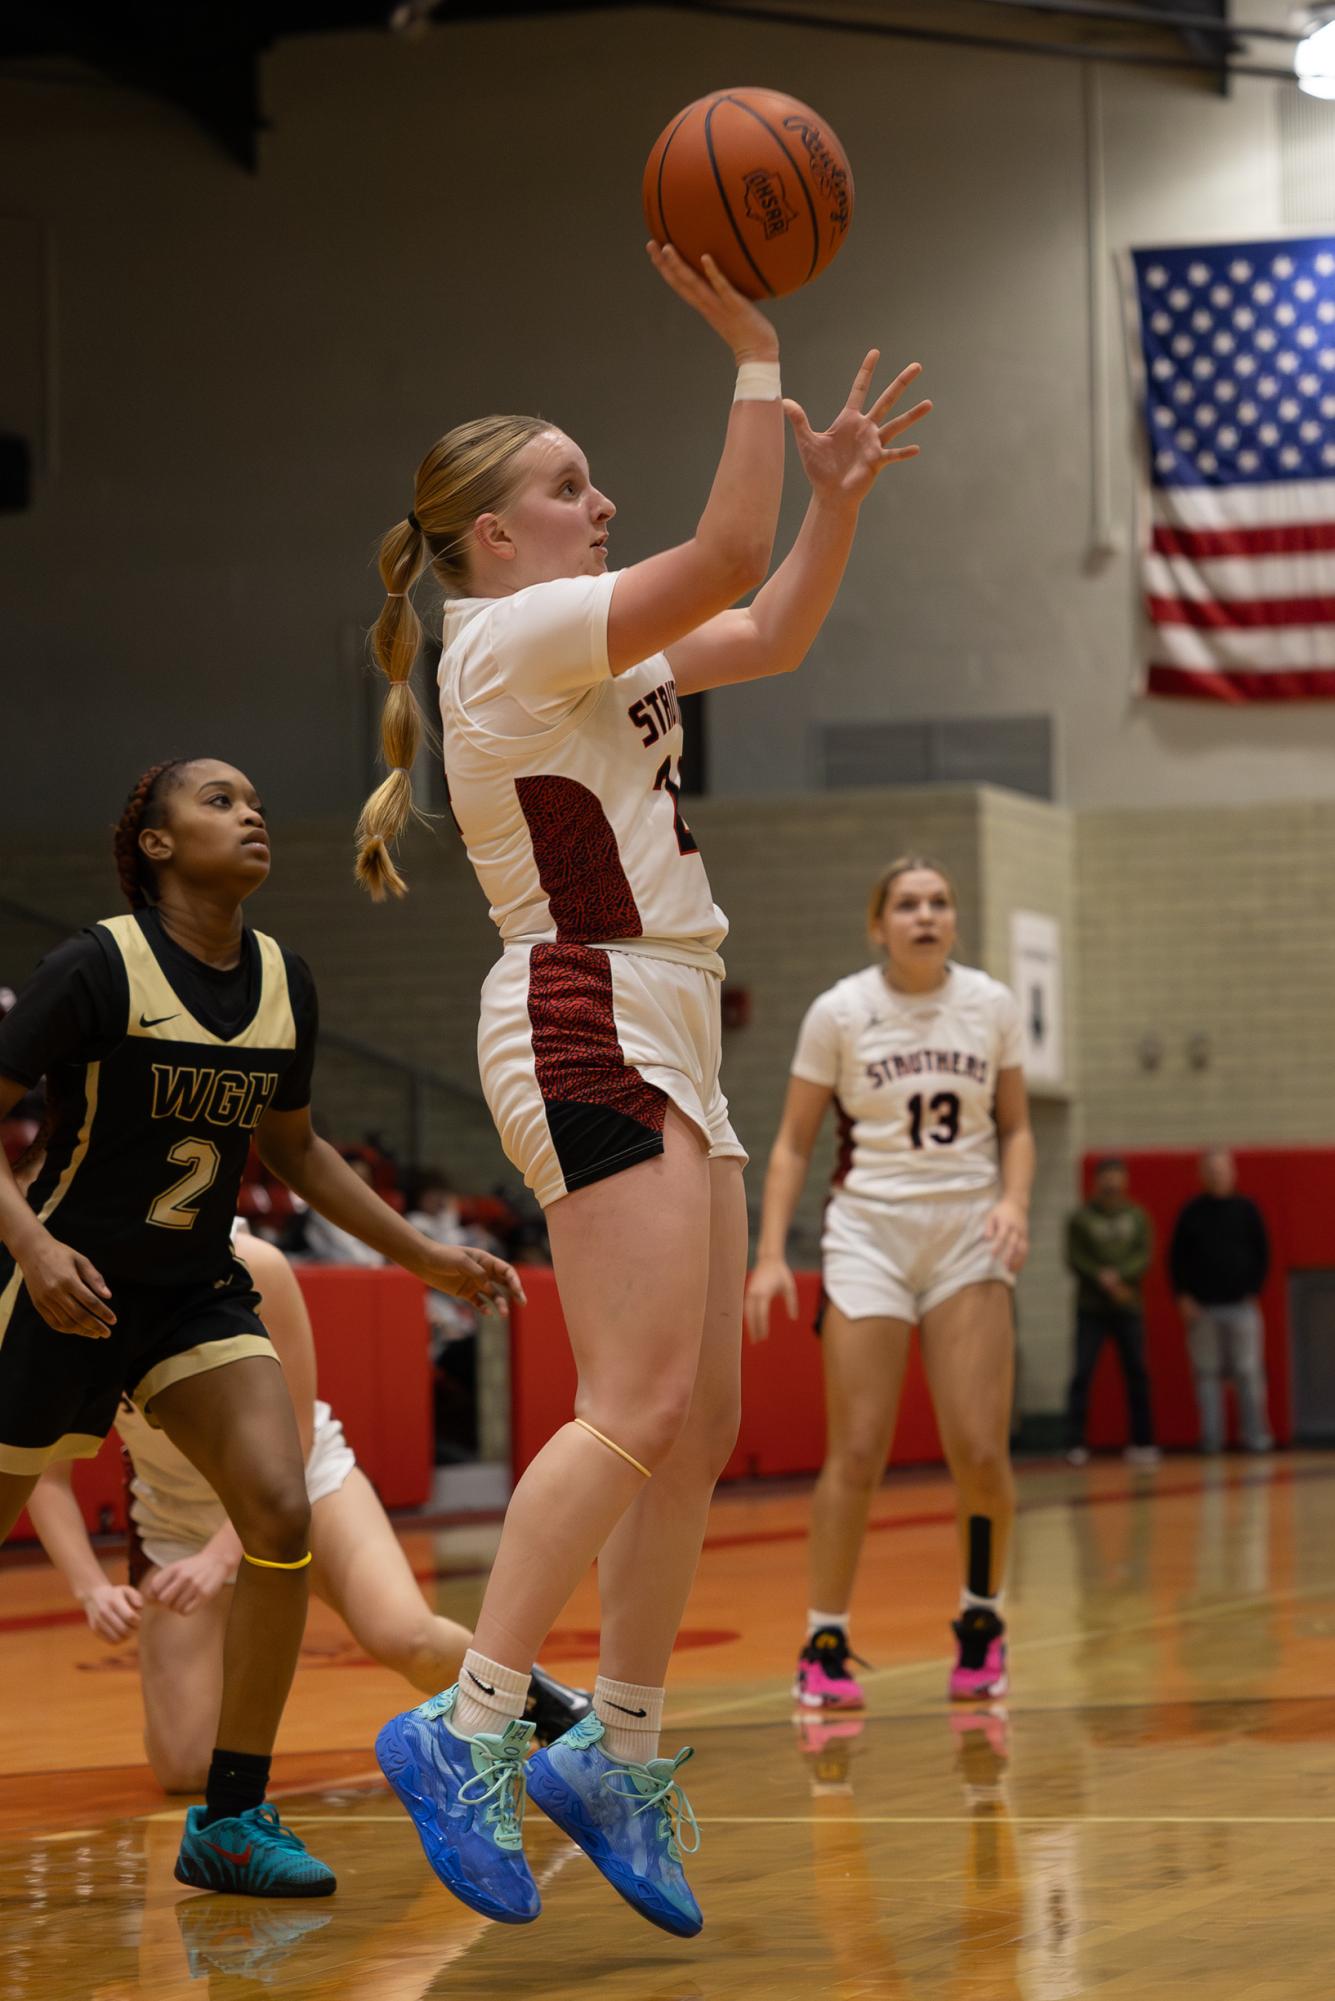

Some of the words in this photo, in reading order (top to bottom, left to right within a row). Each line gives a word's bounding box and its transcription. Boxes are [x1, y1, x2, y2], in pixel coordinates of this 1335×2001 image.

[151, 1063, 279, 1128] WGH
[866, 1050, 987, 1089] STRUTHERS
[908, 1091, 961, 1150] 13
[145, 1135, 222, 1230] 2
